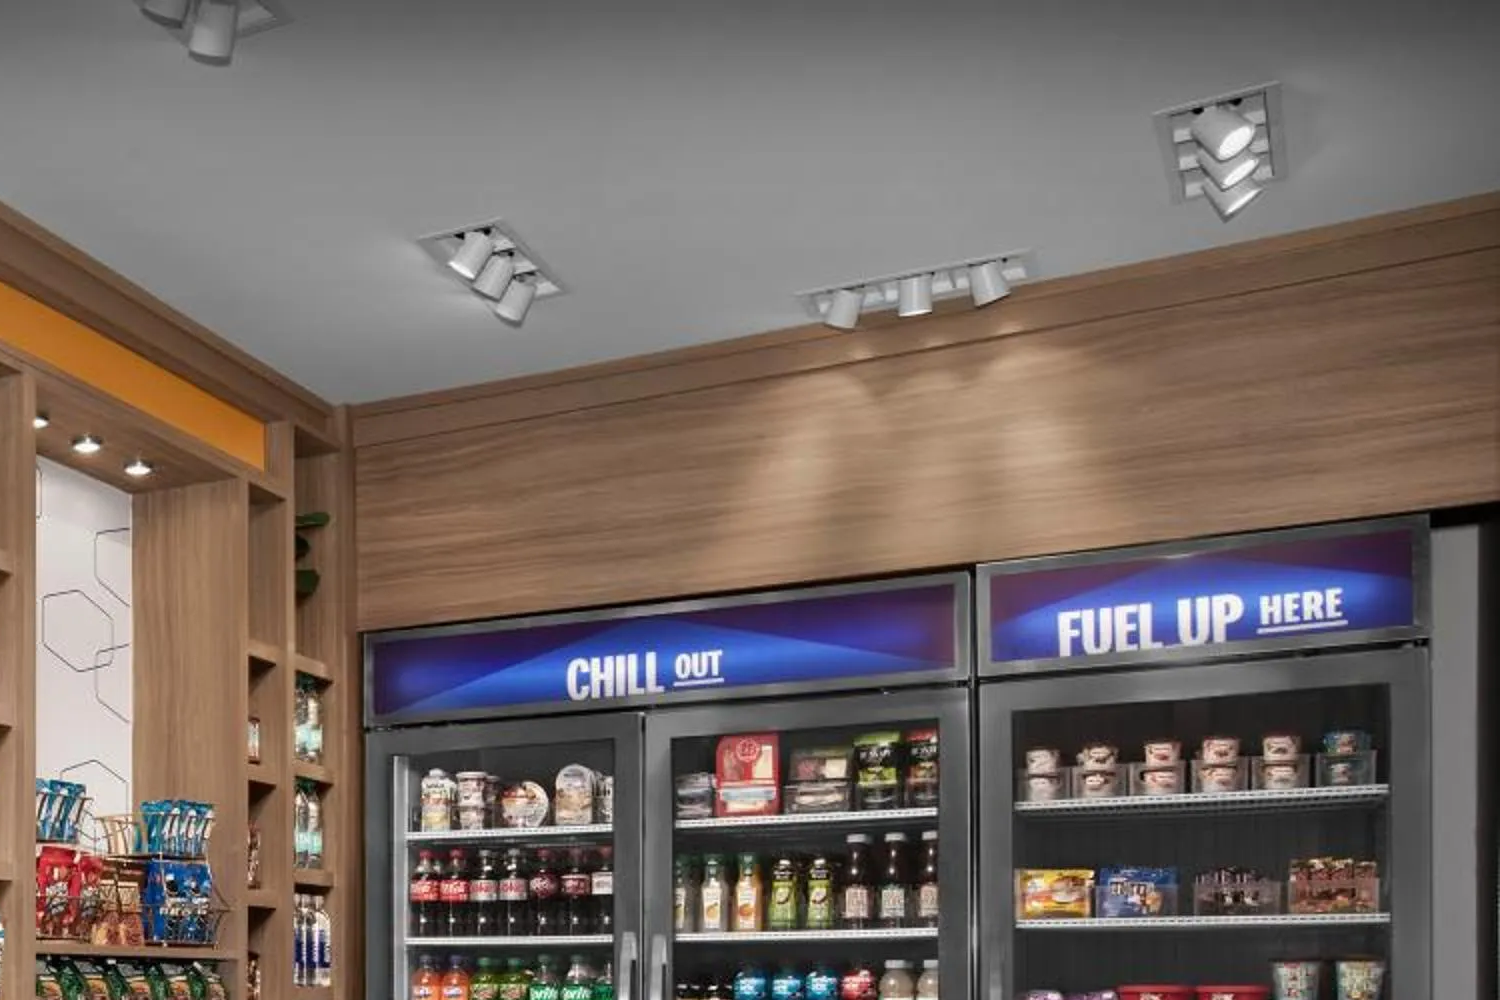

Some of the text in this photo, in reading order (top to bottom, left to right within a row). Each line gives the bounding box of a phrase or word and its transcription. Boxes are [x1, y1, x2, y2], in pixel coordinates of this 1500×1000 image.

[1057, 587, 1344, 657] FUEL UP HERE
[566, 649, 723, 701] CHILL OUT
